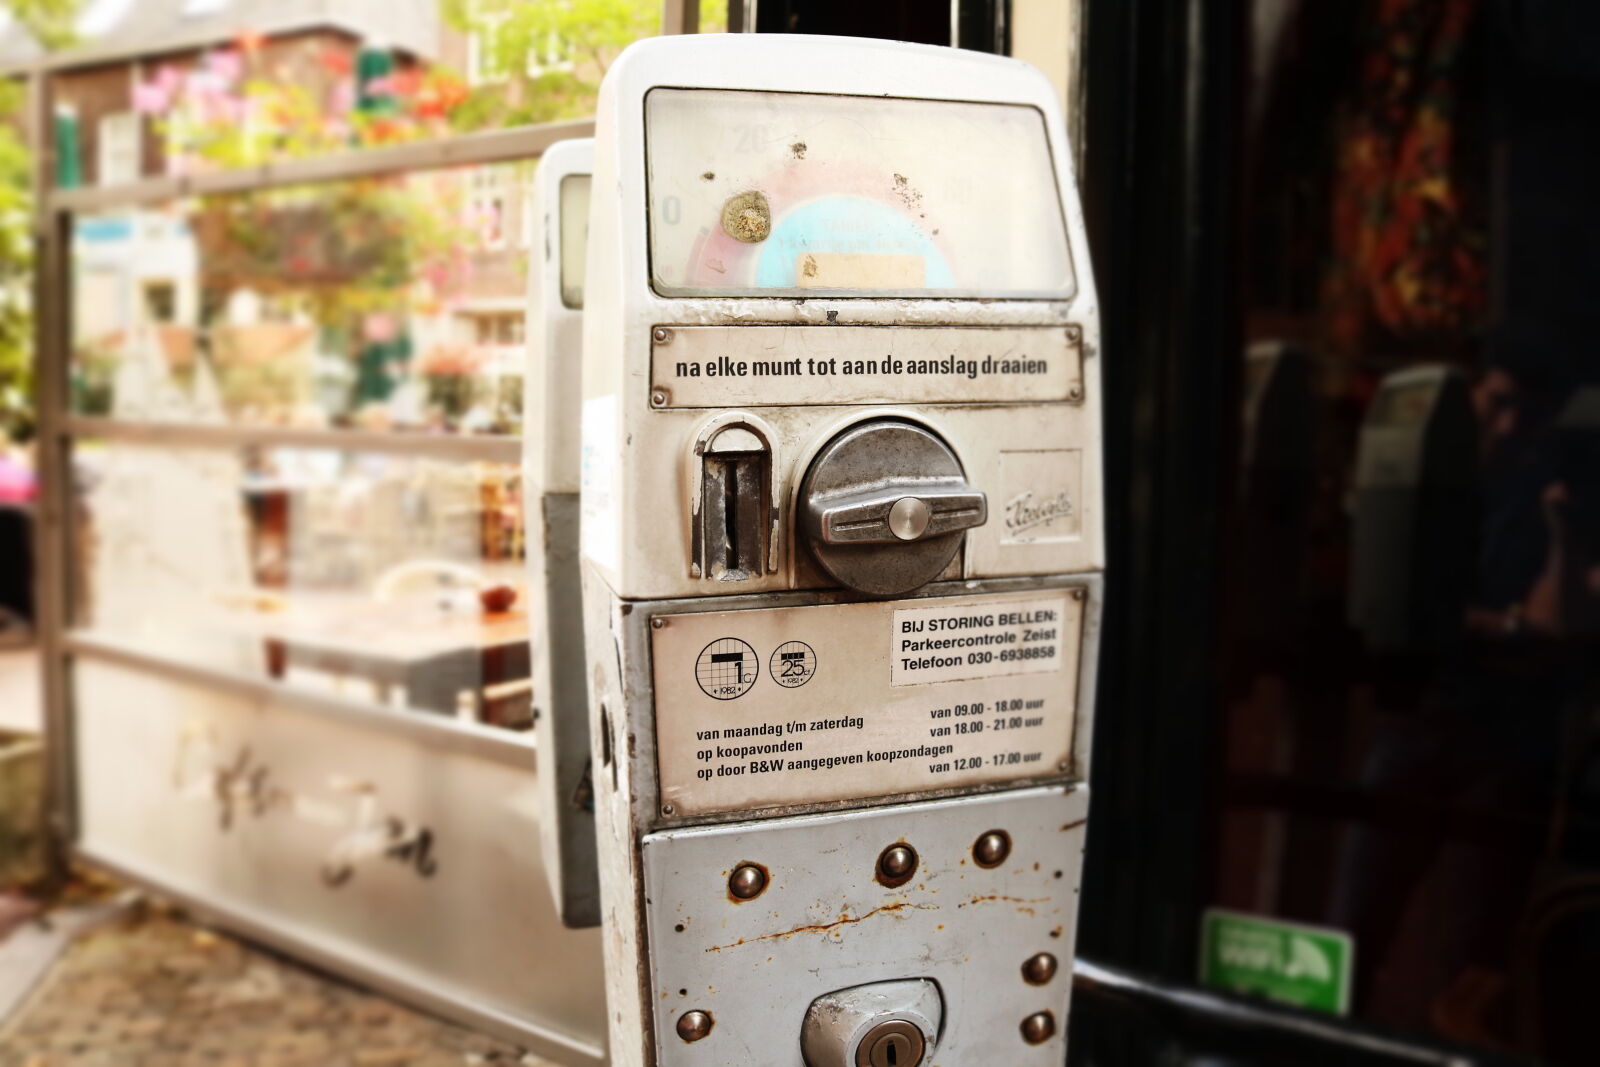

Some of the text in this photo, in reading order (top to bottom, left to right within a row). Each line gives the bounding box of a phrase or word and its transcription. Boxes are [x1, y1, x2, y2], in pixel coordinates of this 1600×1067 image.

[676, 354, 1048, 379] na elke munt tot aan de aanslag draaien
[901, 610, 1058, 634] BIJ STORING BELLEN:
[901, 628, 1057, 652] Parkeercontrole Zeist
[901, 645, 1056, 671] Telefoon 030-6938858
[930, 708, 951, 719] van
[954, 702, 984, 717] 09.00
[995, 698, 1023, 713] 18.00
[1025, 699, 1044, 710] uur
[696, 715, 864, 741] van maandag t/m zaterdag
[930, 726, 951, 738] van
[954, 720, 983, 735] 18.00
[993, 716, 1022, 731] 21.00
[1025, 717, 1044, 728] uur
[696, 740, 803, 762] op koopavonden
[697, 744, 954, 781] op door B&W aangegeven koopzondagen
[928, 762, 950, 774] van
[953, 756, 982, 771] 12.00
[993, 751, 1021, 766] 17.00
[1023, 752, 1042, 763] uur
